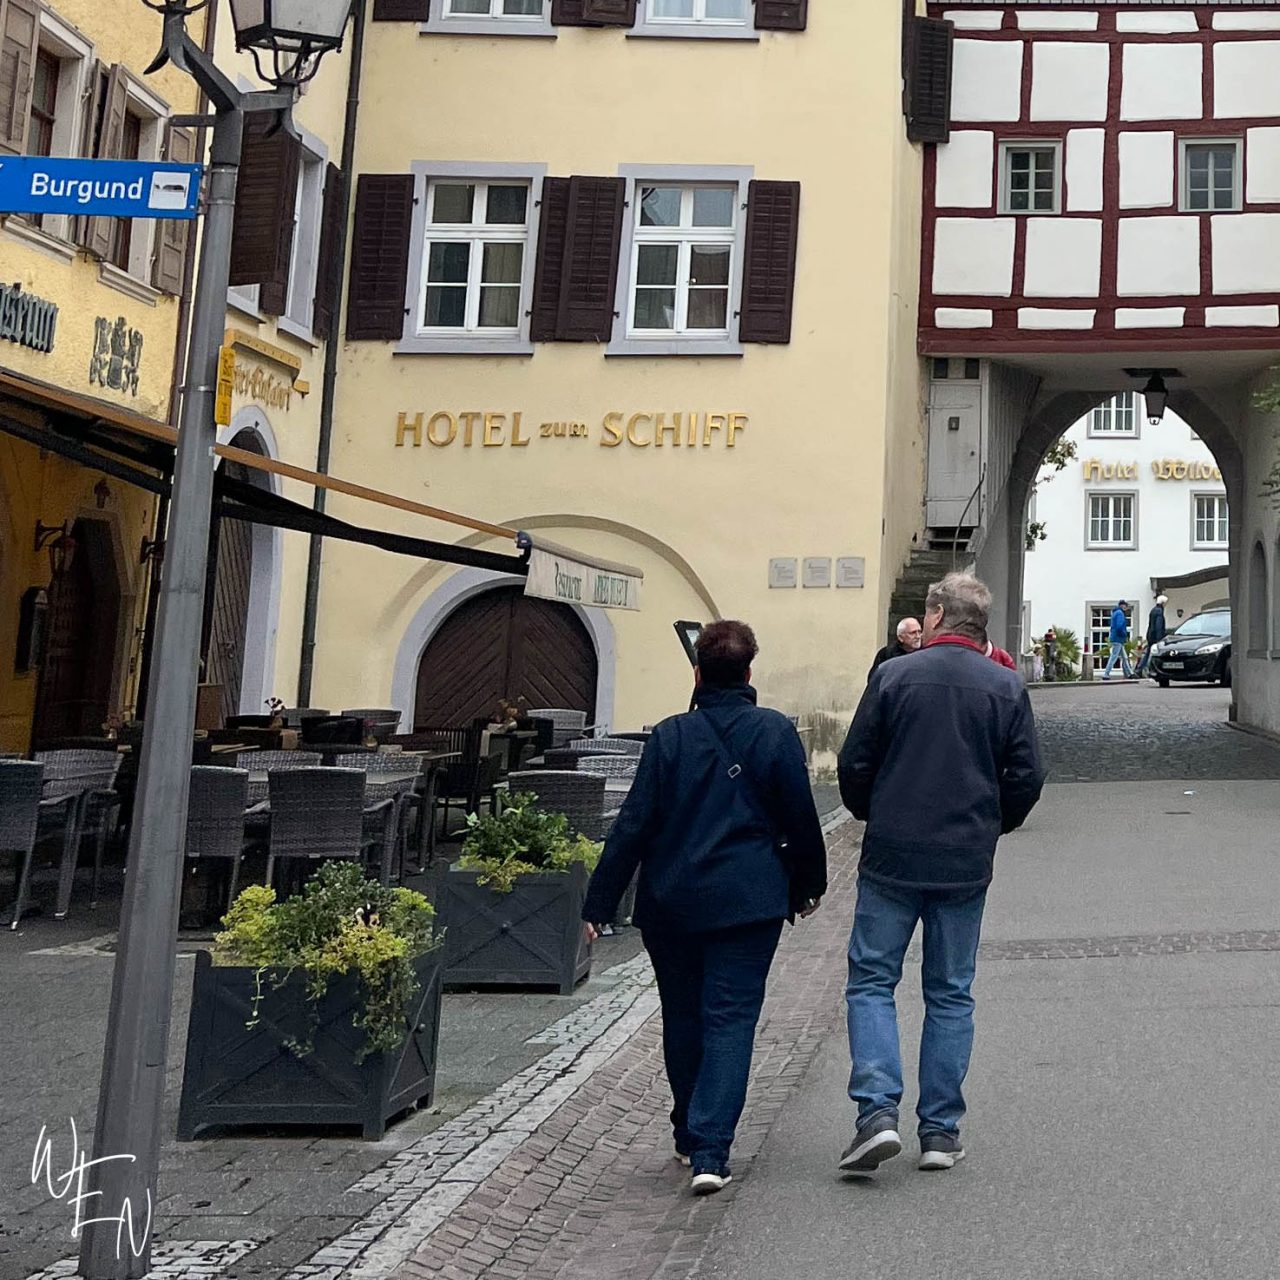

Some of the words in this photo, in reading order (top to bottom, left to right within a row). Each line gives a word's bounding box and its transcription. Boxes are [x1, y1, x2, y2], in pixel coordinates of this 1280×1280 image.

[30, 172, 144, 204] Burgund
[395, 411, 531, 448] HOTEL
[539, 421, 589, 439] zum
[600, 411, 752, 448] SCHIFF
